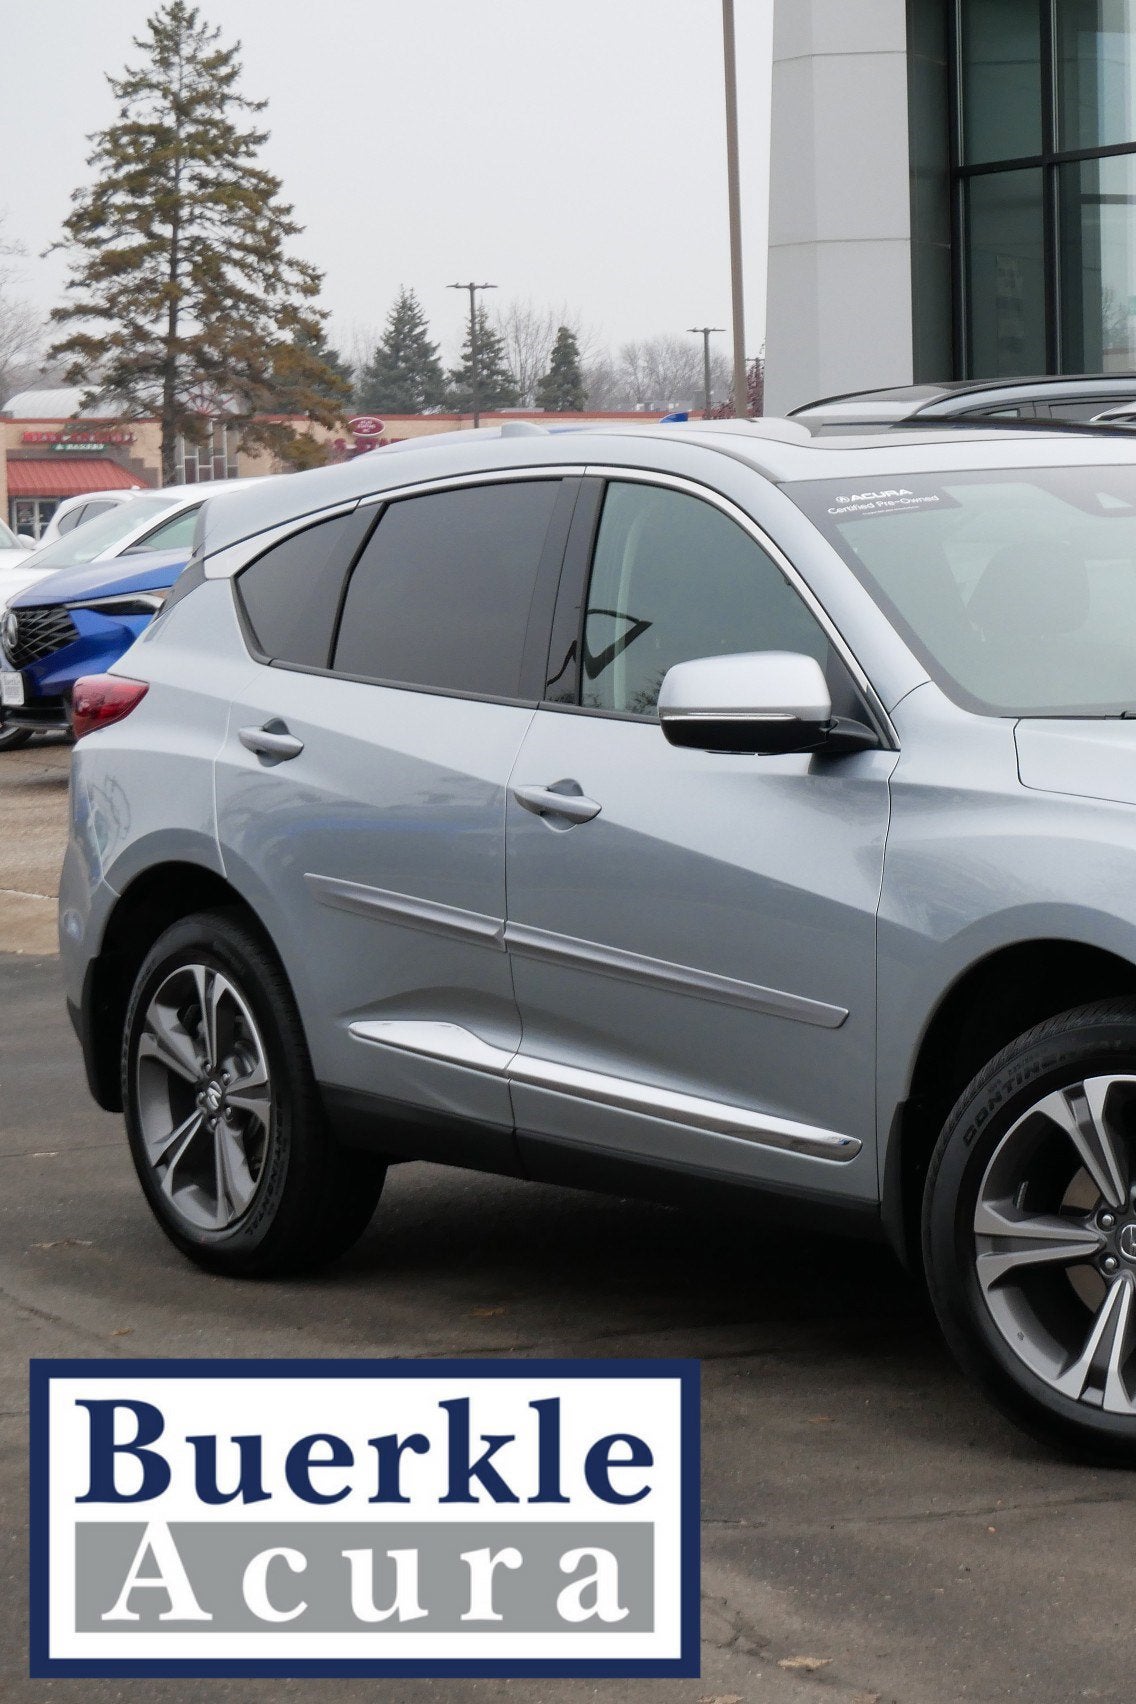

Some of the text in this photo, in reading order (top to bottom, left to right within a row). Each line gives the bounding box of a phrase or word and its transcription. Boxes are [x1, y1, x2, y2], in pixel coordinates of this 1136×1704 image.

[851, 489, 914, 501] ACURA
[827, 502, 875, 515] Certified
[876, 494, 940, 507] Pre-Owned
